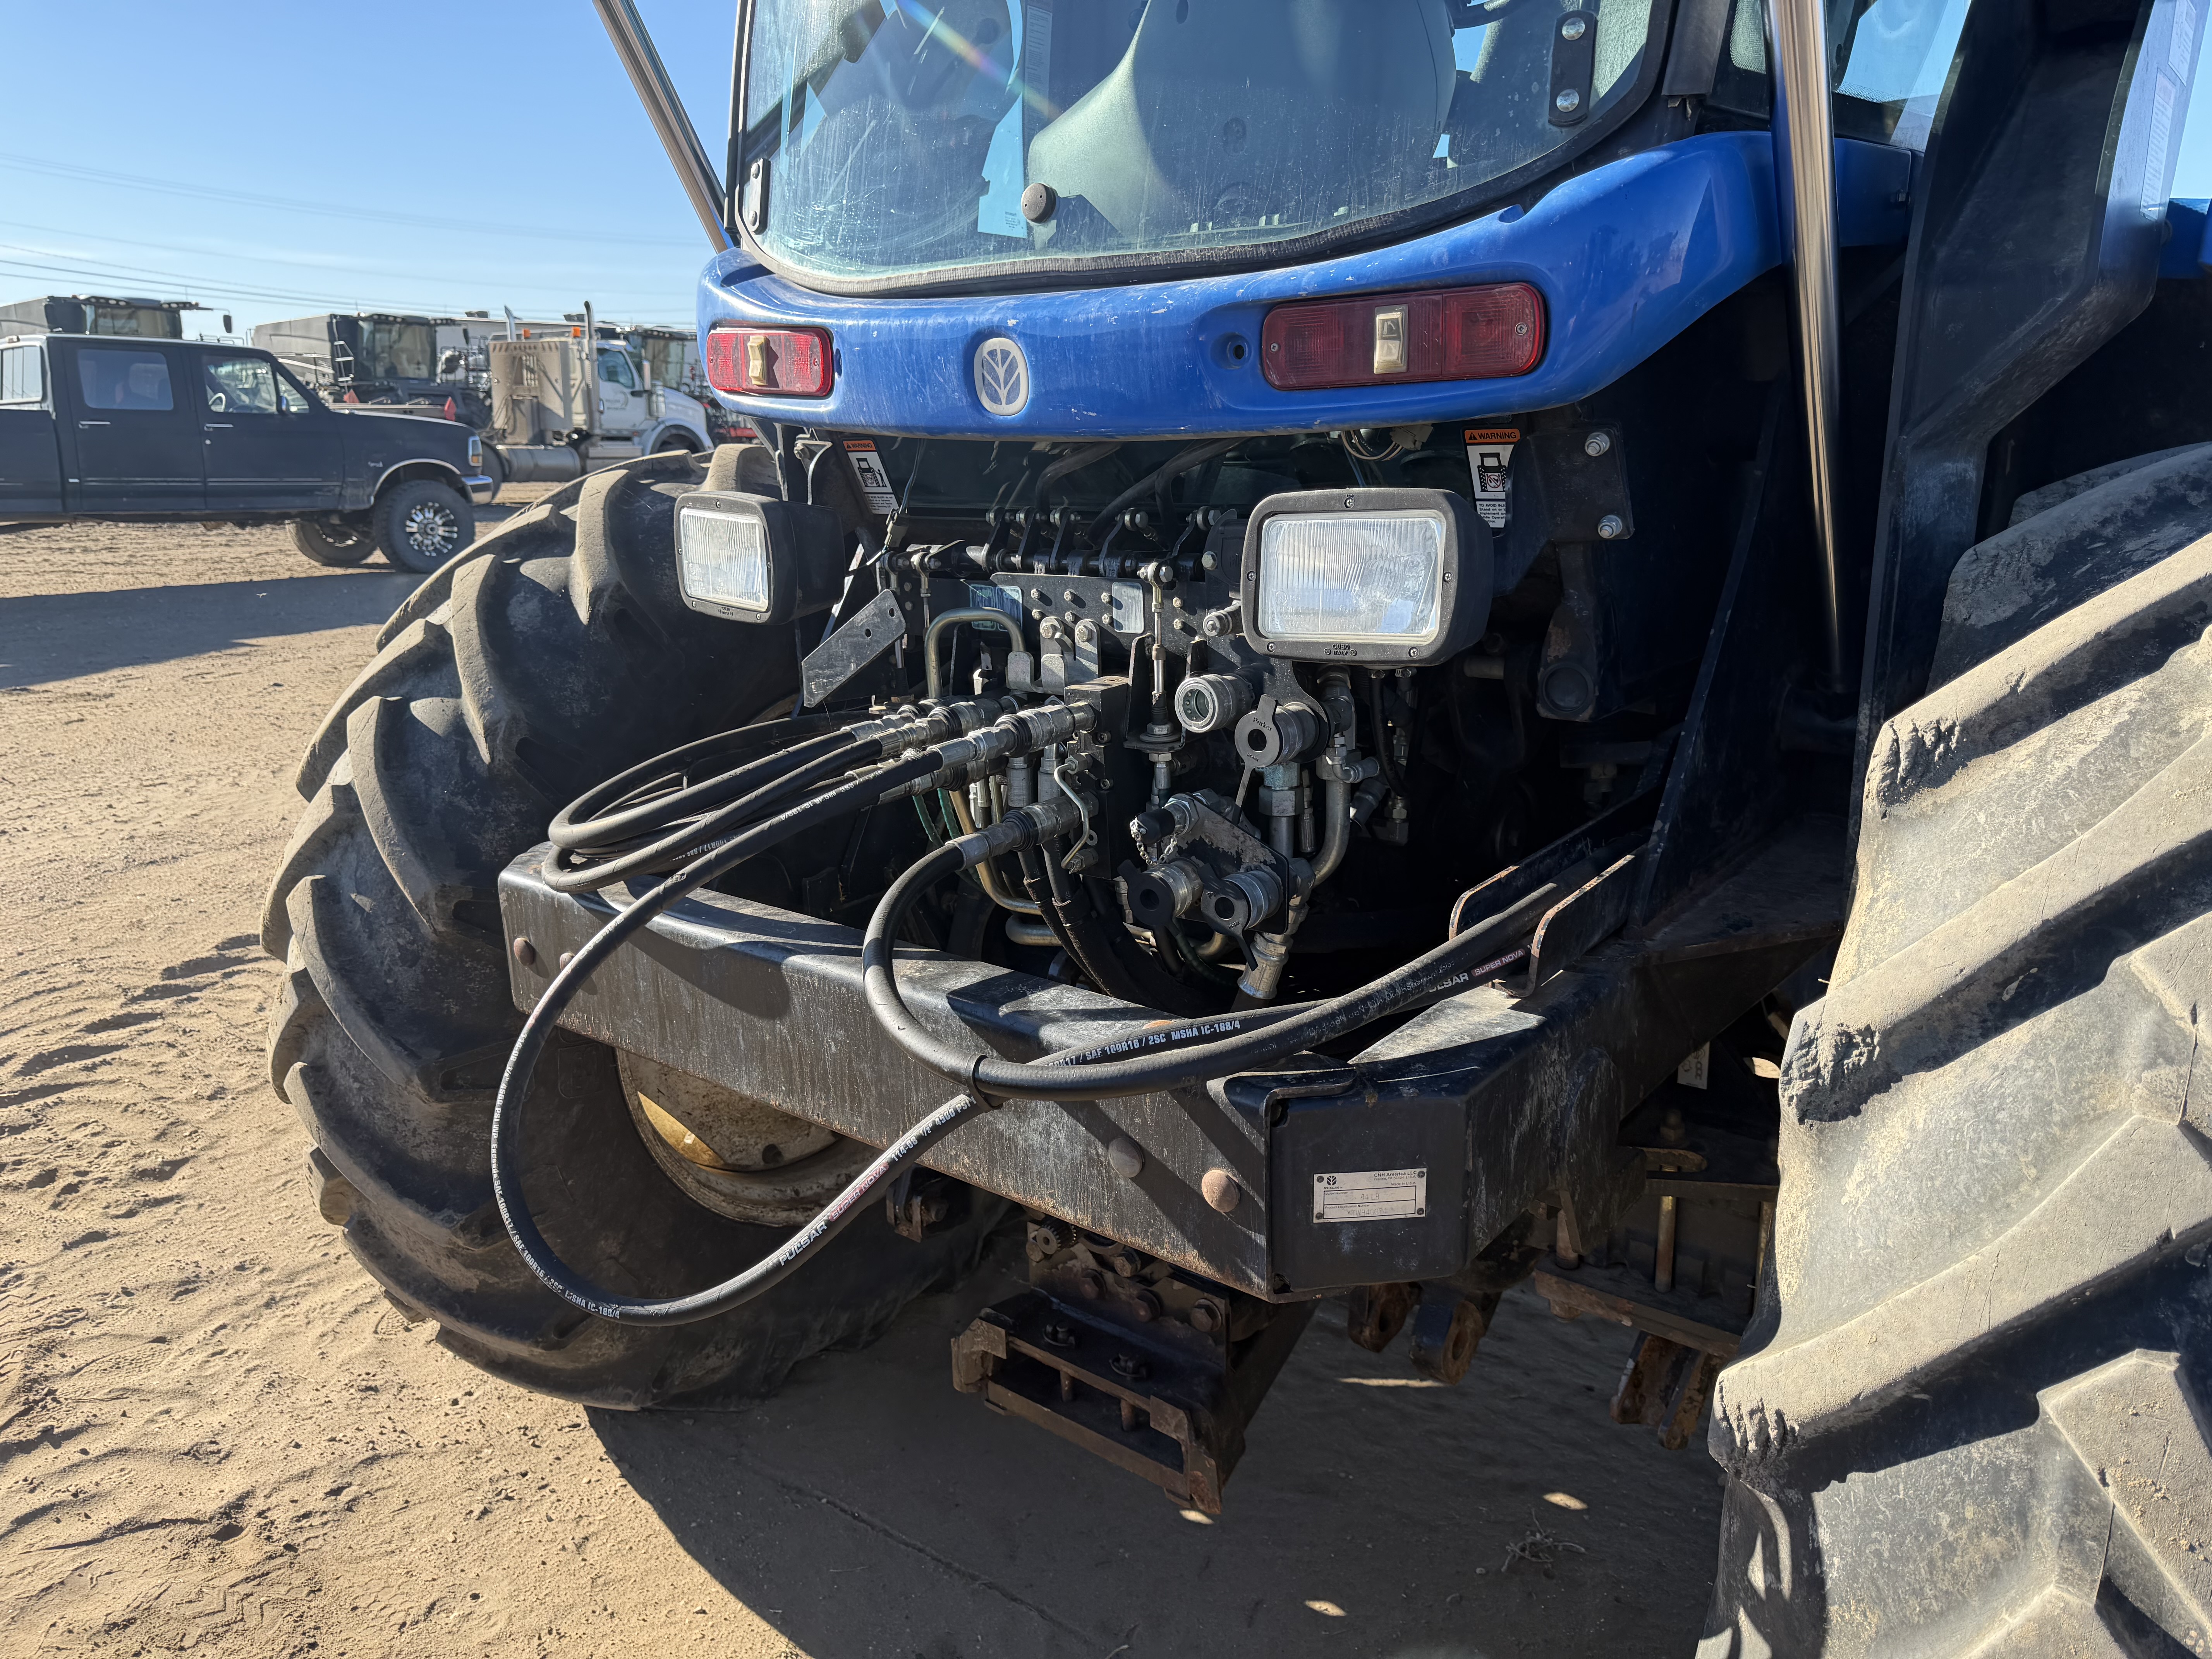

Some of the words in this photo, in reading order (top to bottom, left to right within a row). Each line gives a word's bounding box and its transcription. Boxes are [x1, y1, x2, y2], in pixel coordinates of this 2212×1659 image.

[1253, 717, 1273, 732] Parker
[1474, 960, 1501, 975] SUPER
[1502, 950, 1524, 963] NOVA
[1085, 1048, 1103, 1060] SAE
[1104, 1039, 1140, 1055] 100R16
[1148, 1033, 1166, 1045] 2SC
[1171, 1027, 1199, 1040] MSHA
[1201, 1020, 1240, 1035] IC-188/4
[779, 1221, 827, 1266] PULSAR
[833, 1190, 860, 1219] SUPER
[862, 1166, 886, 1191] NOVA
[892, 1136, 918, 1161] 114-08
[935, 1108, 956, 1126] 4500
[498, 1197, 514, 1229] 100R17
[513, 1235, 526, 1251] SAE
